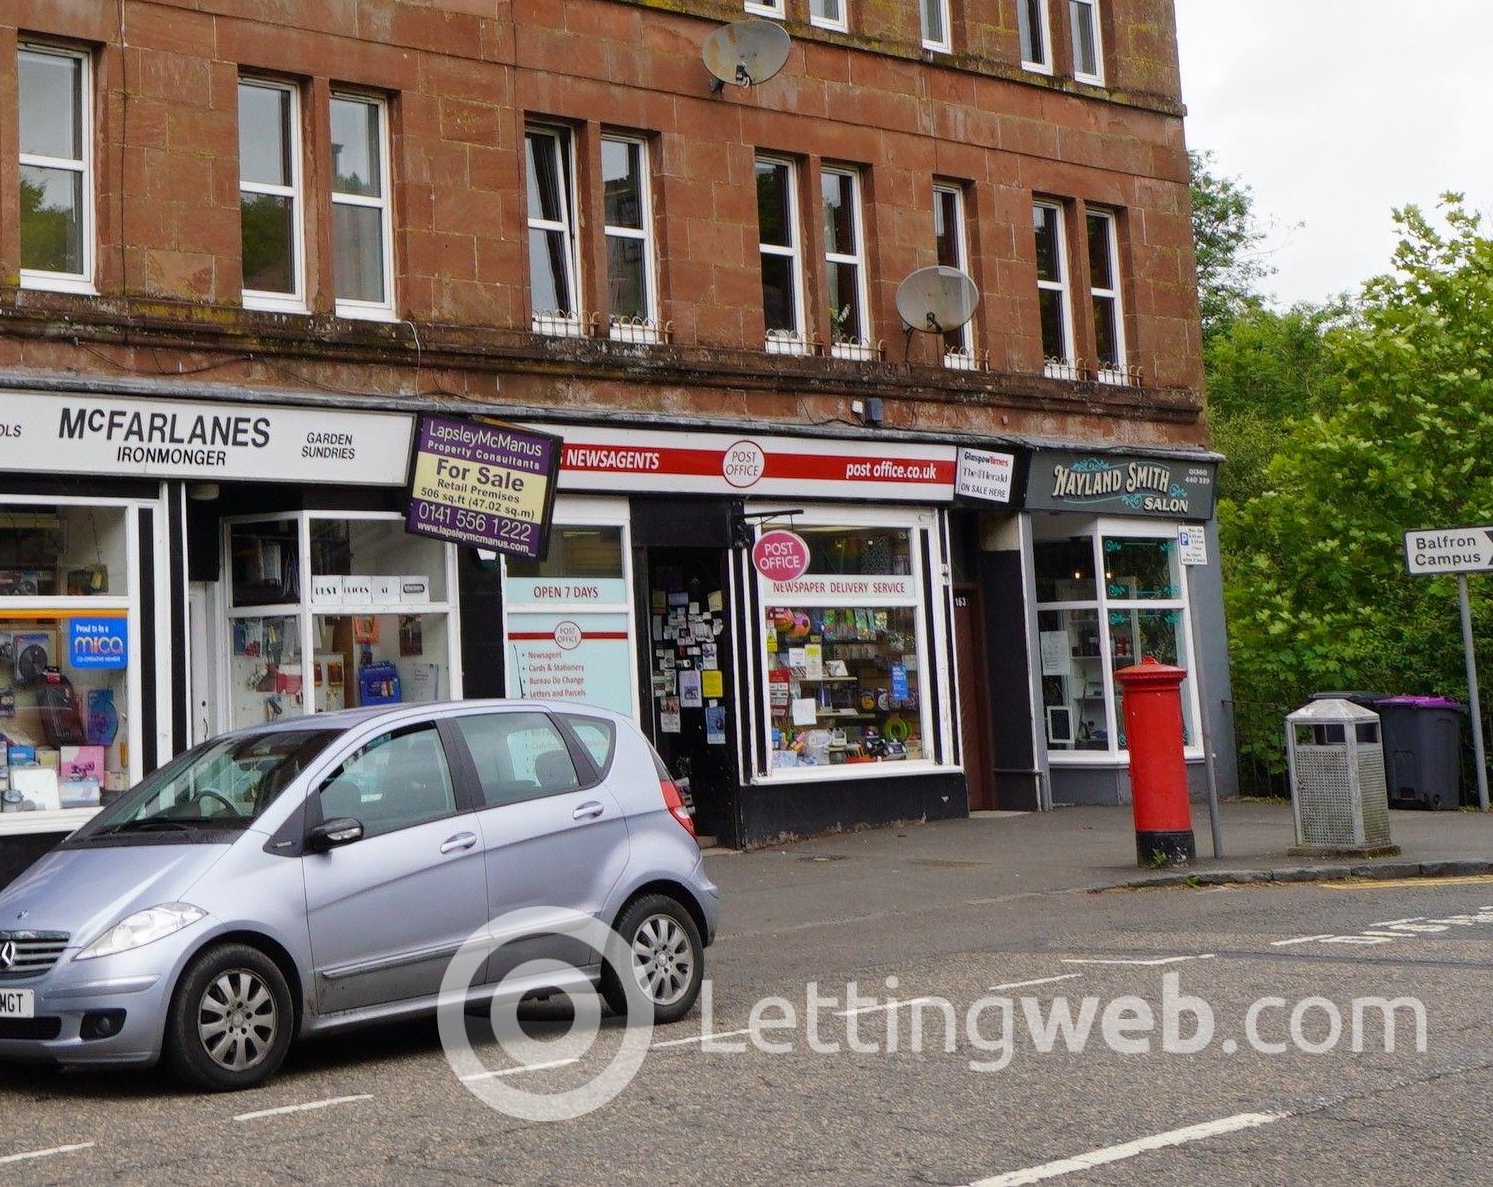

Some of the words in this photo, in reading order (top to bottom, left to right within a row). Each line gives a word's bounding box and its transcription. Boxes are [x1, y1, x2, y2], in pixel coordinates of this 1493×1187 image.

[307, 432, 353, 445] GARDEN
[429, 420, 542, 457] LapsleyMcManus
[117, 447, 226, 466] IRONMONGER
[301, 445, 355, 460] SUNDRIES
[428, 440, 472, 458] Property
[476, 449, 540, 470] Consultants
[567, 449, 659, 469] NEWSAGENTS
[732, 451, 757, 462] POST
[436, 458, 470, 481] For
[477, 467, 524, 492] Sale
[726, 465, 759, 477] OFFICE
[846, 462, 870, 479] post
[873, 461, 937, 479] office.co.uk
[1126, 462, 1170, 493] SMITH
[437, 479, 467, 492] Retail
[471, 486, 520, 503] Premises
[961, 483, 971, 492] ON
[971, 485, 987, 494] SALE
[988, 488, 1006, 498] HERE
[421, 487, 439, 499] 506
[443, 492, 465, 506] sq.ft
[468, 498, 502, 512] (47.02
[505, 505, 535, 520] sq.m)
[1143, 497, 1189, 513] SALON
[419, 502, 451, 524] 0141
[456, 510, 486, 532] 556
[493, 519, 532, 542] 1222
[417, 522, 529, 553] www.lapsleymcmanus.com
[1416, 536, 1476, 549] Balfron
[764, 542, 794, 556] POST
[760, 555, 801, 570] OFFICE
[1415, 553, 1481, 566] Campus
[533, 586, 561, 598] OPEN
[565, 587, 570, 598] 7
[574, 586, 599, 598] DAYS
[773, 582, 826, 593] NEWSPAPER
[830, 582, 868, 593] DELIVERY
[873, 582, 905, 593] SERVICE
[559, 627, 575, 635] POST
[75, 636, 124, 654] mica
[557, 635, 578, 643] OFFICE
[528, 652, 562, 661] Newsagent
[528, 664, 546, 672] Cards
[553, 663, 584, 672] Stationery
[529, 677, 551, 685] Bureau
[562, 677, 584, 686] Change
[530, 690, 550, 698] Letters
[564, 689, 586, 697] Parcels
[0, 993, 23, 1013] MGT
